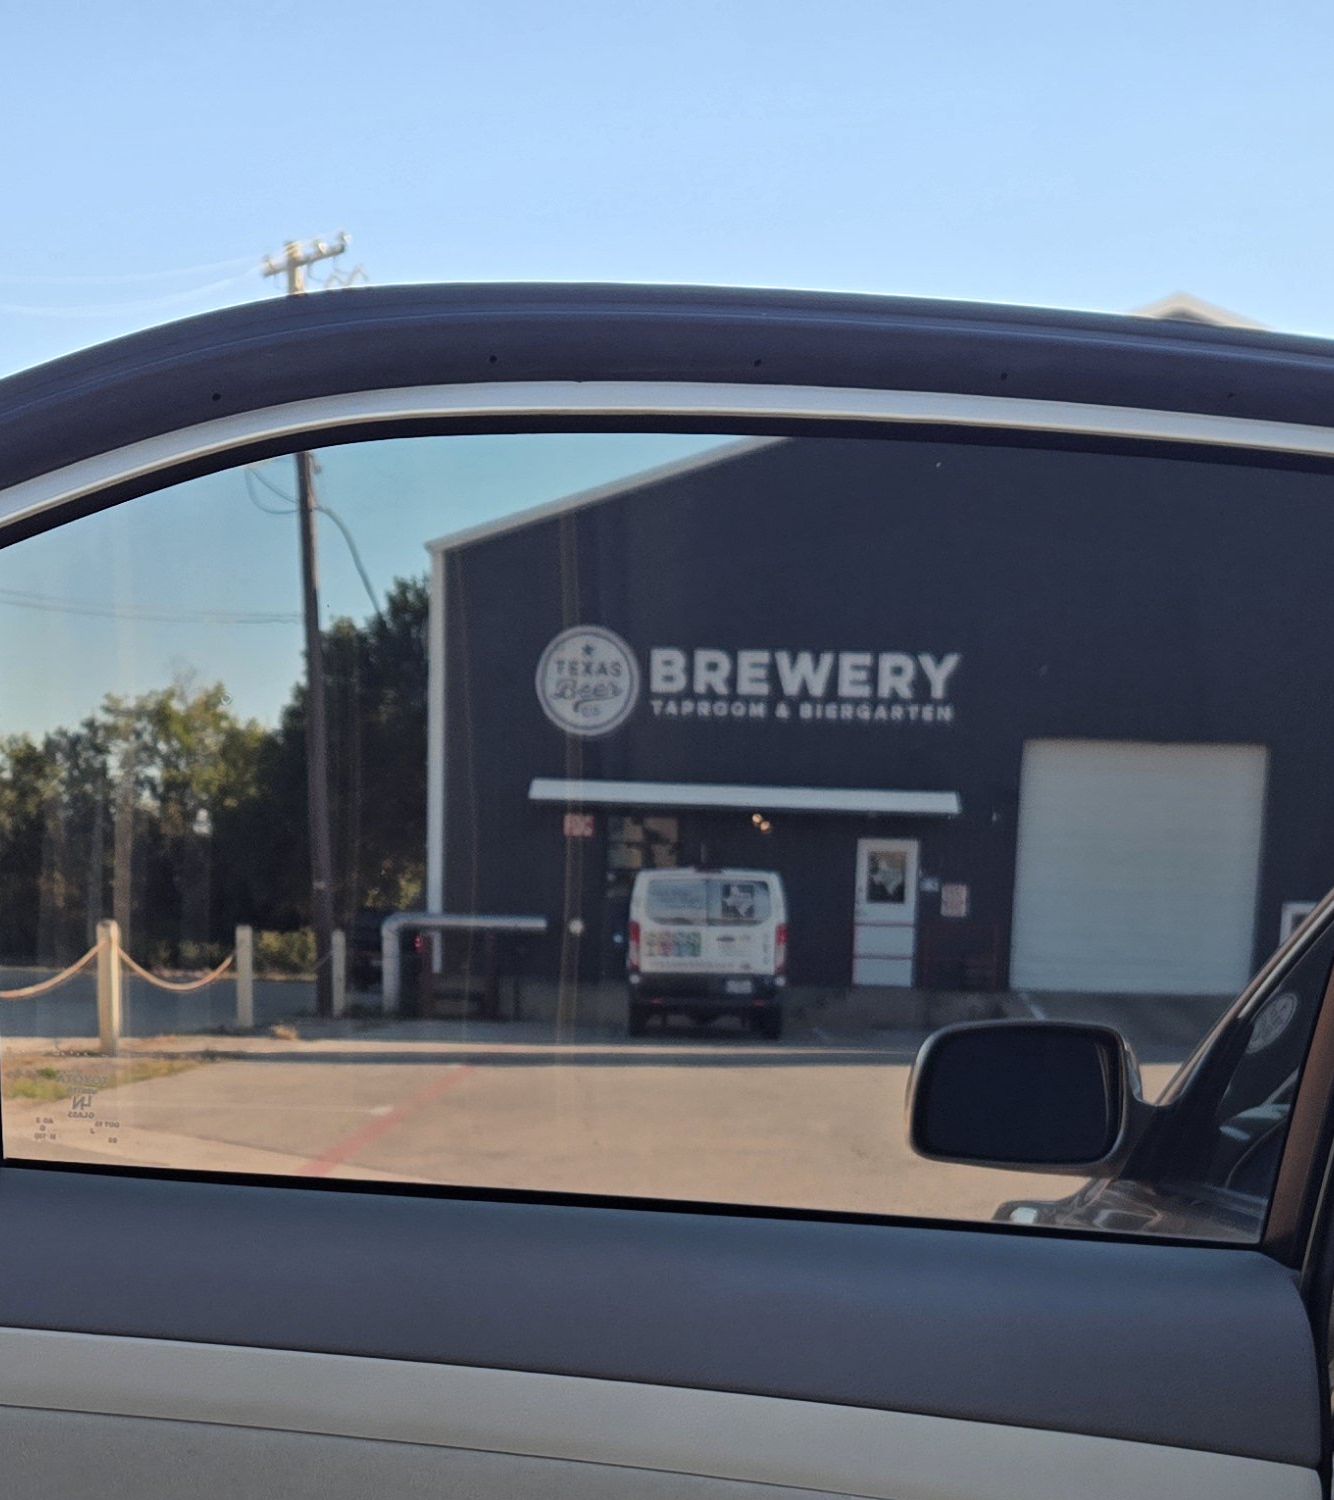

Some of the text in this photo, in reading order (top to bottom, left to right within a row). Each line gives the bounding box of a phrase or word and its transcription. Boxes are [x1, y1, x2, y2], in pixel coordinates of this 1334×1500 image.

[555, 656, 622, 677] TEXAS
[650, 647, 961, 698] BREWERY
[550, 677, 622, 703] Beer
[651, 700, 954, 722] TAPROOM & BIERGARTEN
